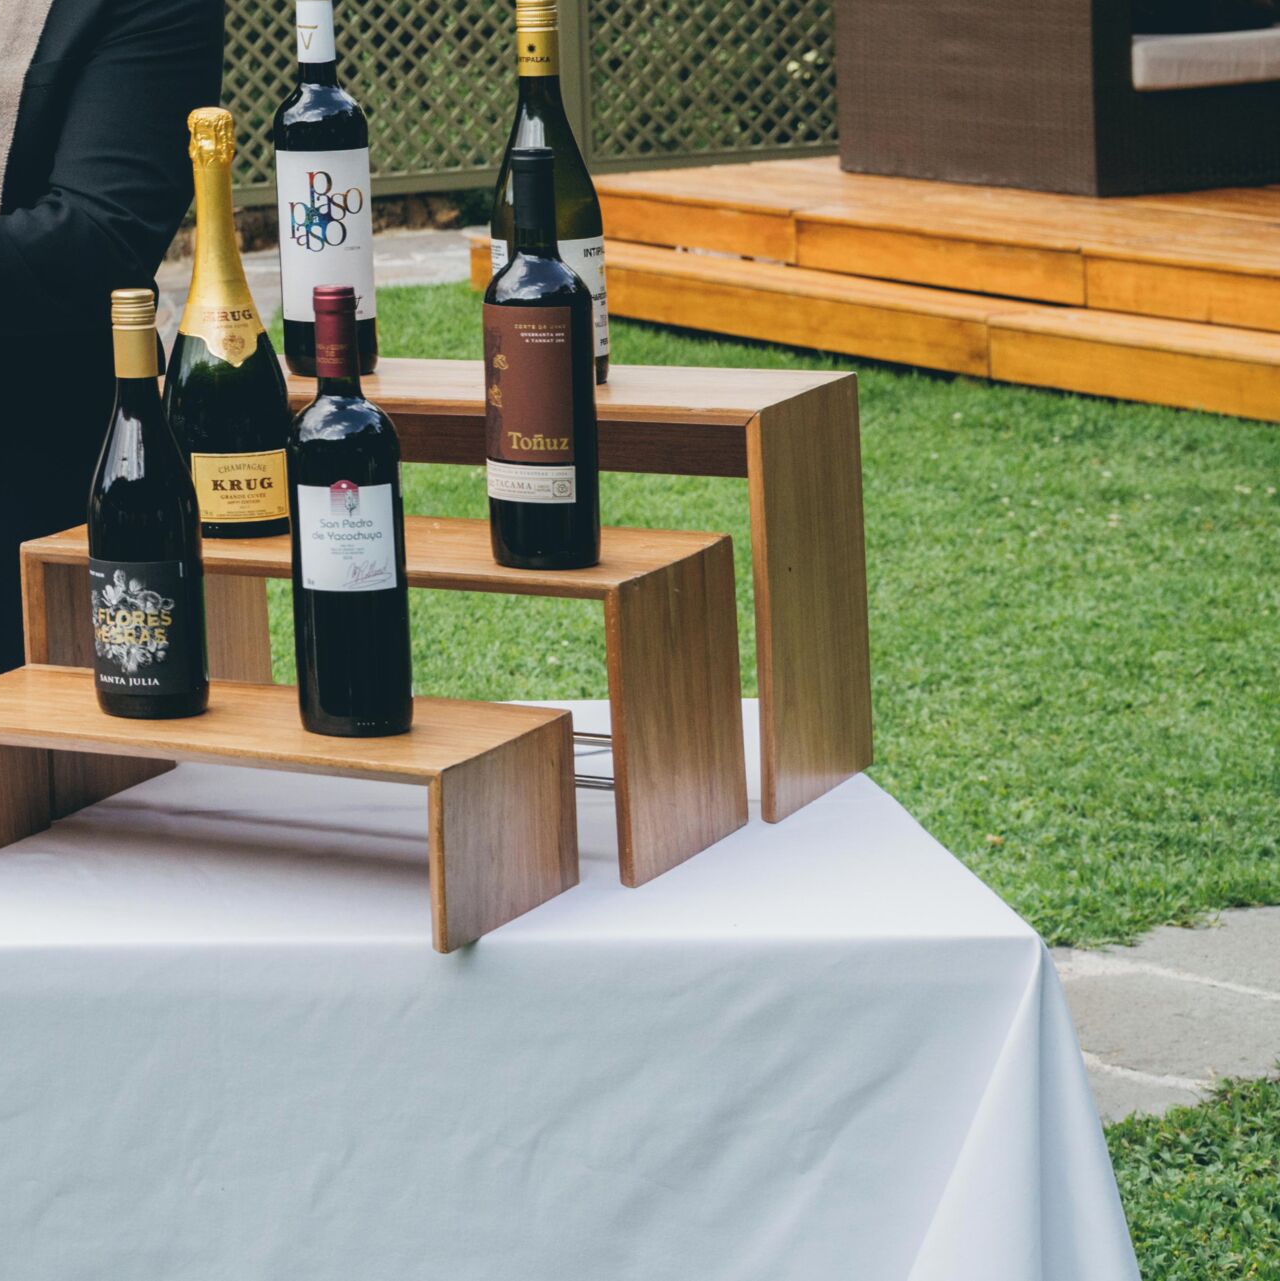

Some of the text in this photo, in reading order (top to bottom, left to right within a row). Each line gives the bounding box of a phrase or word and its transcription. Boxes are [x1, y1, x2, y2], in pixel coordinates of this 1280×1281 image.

[202, 309, 254, 322] KRUG
[507, 431, 569, 451] Toñuz
[218, 463, 267, 473] CHAMPAGNE
[211, 477, 273, 491] KRUG
[495, 479, 532, 490] TACAMA
[320, 518, 373, 529] San Pedro
[312, 531, 383, 541] de Yacochuya
[97, 607, 172, 627] FLORES
[100, 674, 160, 687] SANTA JULIA
